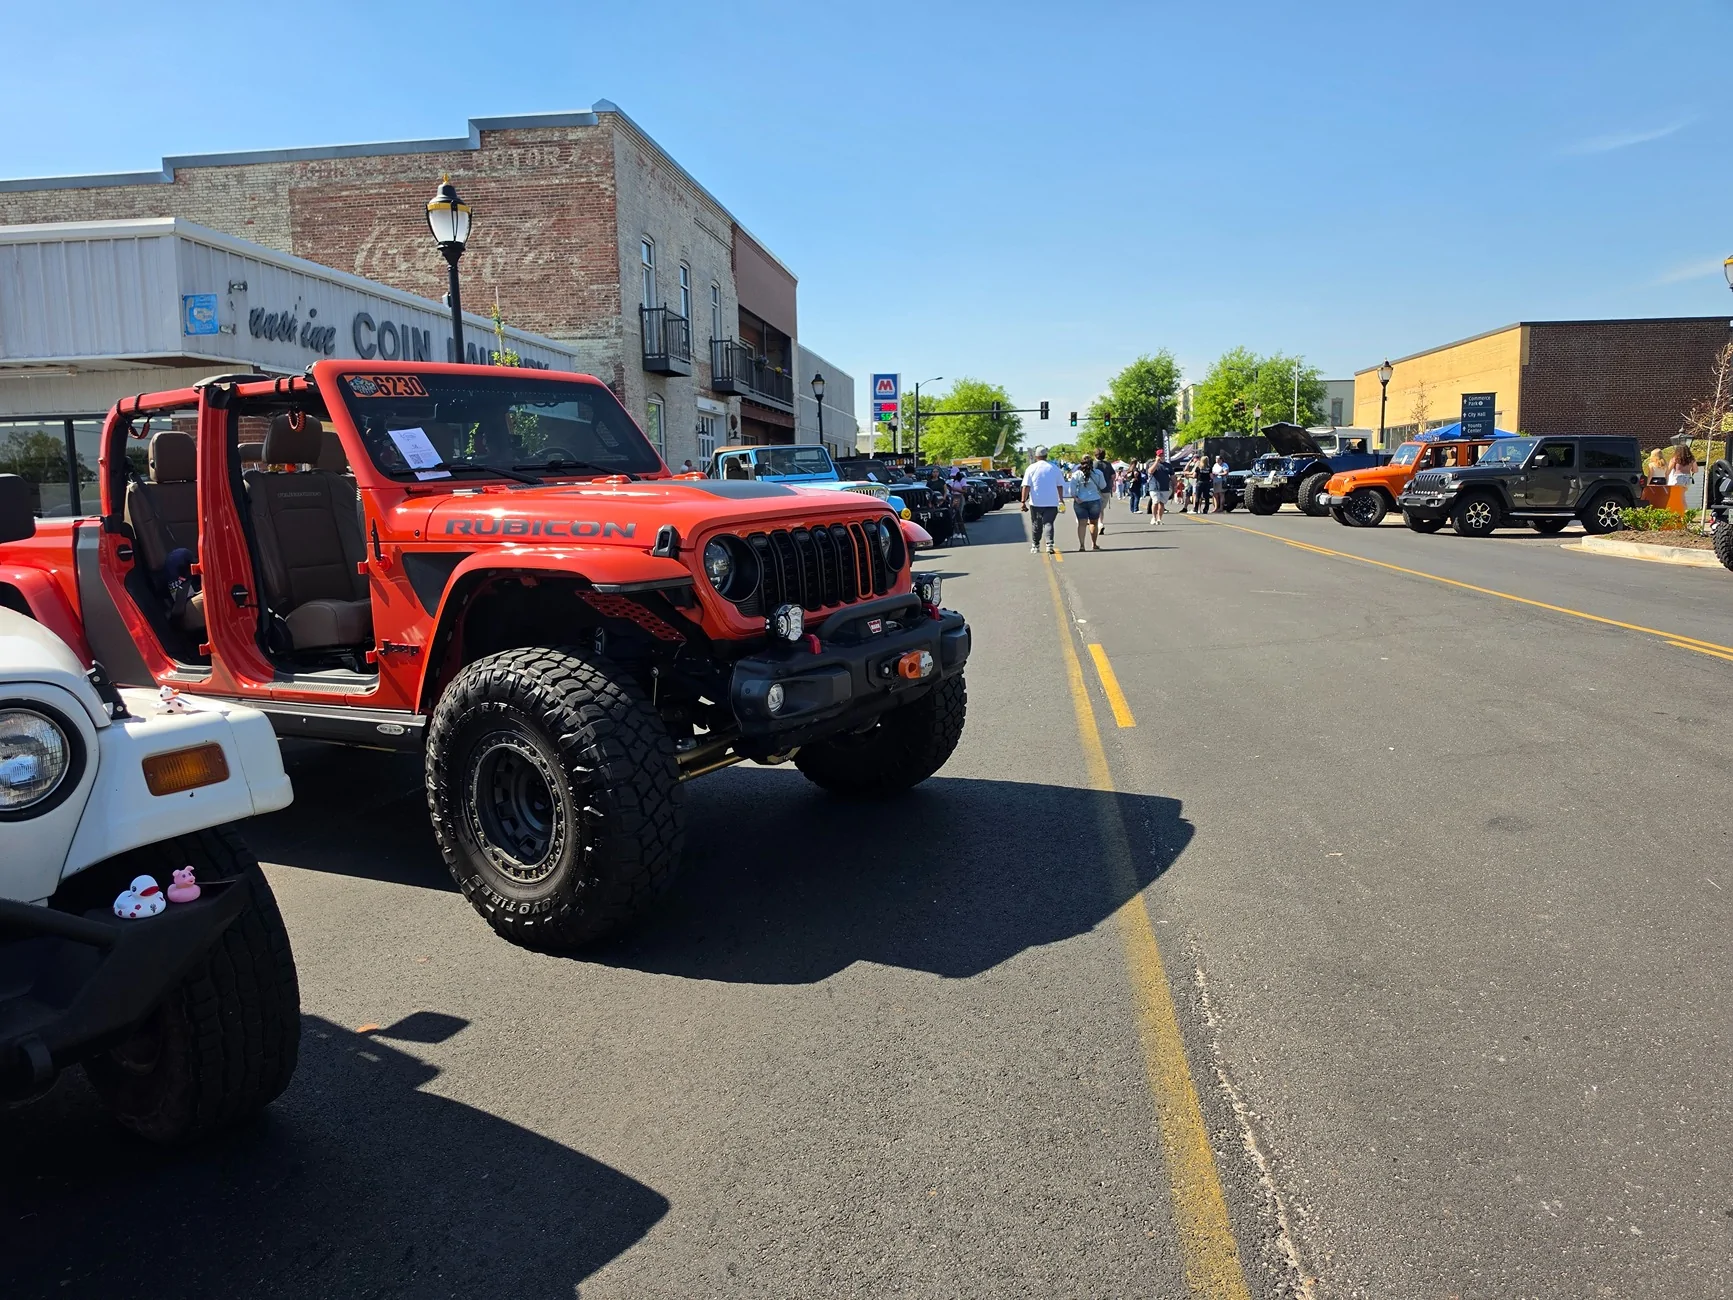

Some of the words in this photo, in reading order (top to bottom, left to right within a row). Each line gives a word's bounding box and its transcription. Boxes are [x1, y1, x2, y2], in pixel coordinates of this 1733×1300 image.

[353, 311, 431, 361] COIN
[372, 376, 427, 396] 6230
[444, 518, 637, 539] RUBICON
[469, 874, 517, 913] TIRES
